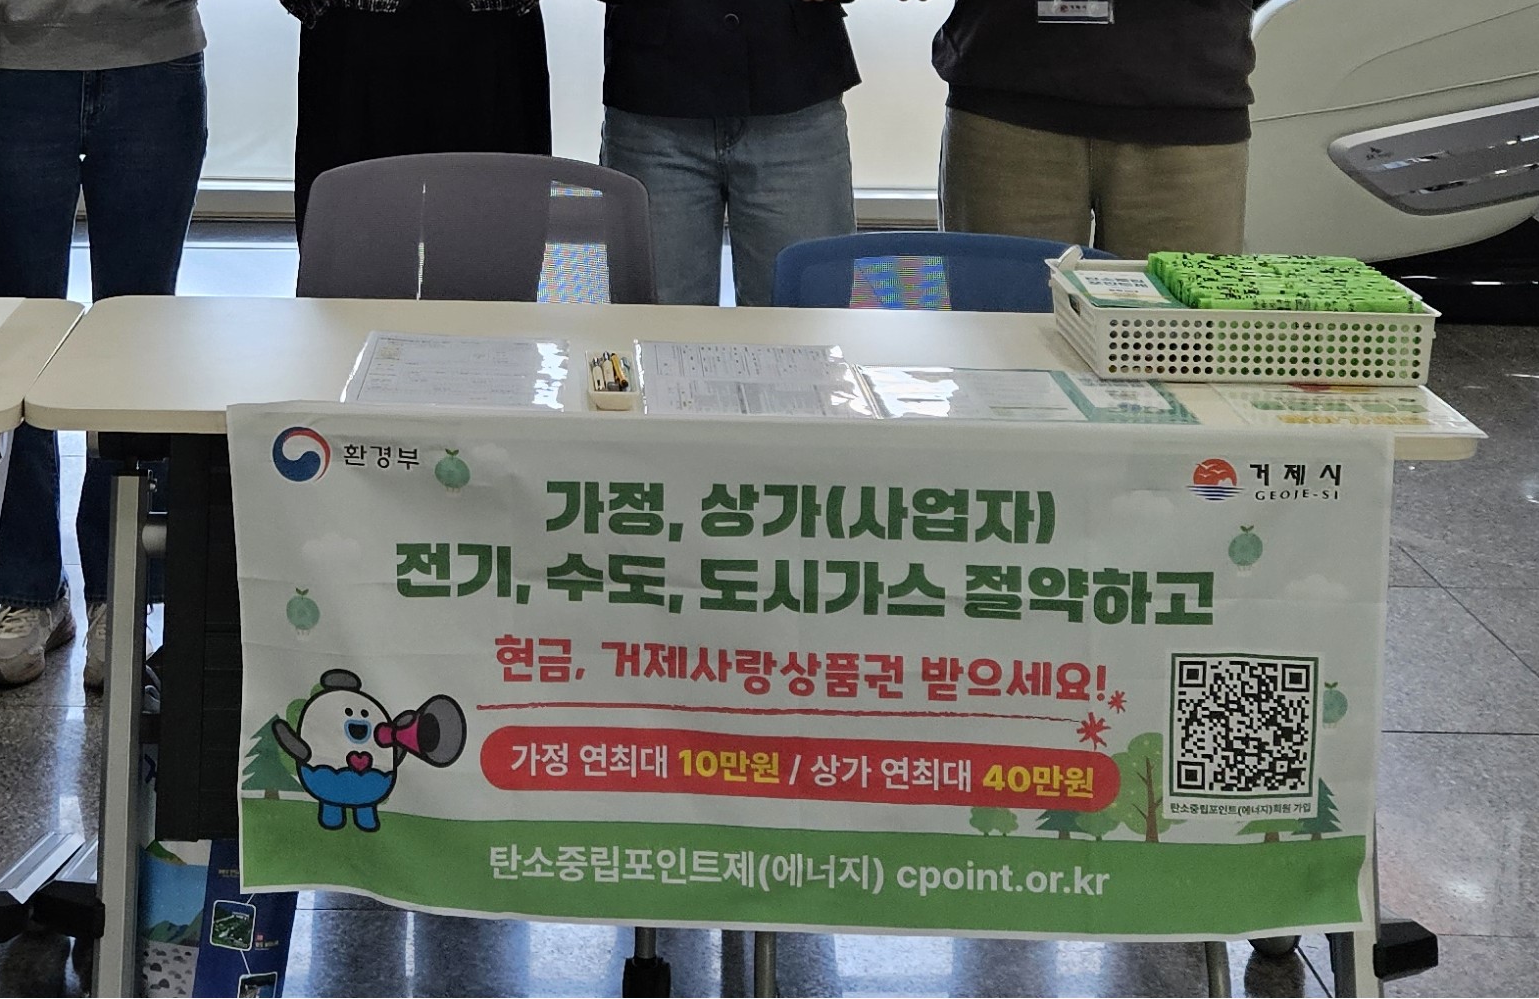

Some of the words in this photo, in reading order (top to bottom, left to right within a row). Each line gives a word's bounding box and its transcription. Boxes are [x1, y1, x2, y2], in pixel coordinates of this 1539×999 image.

[343, 443, 420, 471] 환경부
[1250, 463, 1341, 486] 거제시
[546, 480, 683, 542] 가정,
[701, 482, 1057, 544] 상가(사업자)
[1255, 489, 1338, 501] GEOJE-SI
[395, 543, 531, 604] 전기,
[547, 553, 683, 614] 수도,
[700, 558, 946, 618] 도시가스
[962, 563, 1215, 626] 절약하고
[495, 634, 586, 682] 현금,
[602, 641, 904, 700] 거제사랑상품권
[921, 655, 1108, 702] 받으세요!
[511, 741, 568, 778] 가정
[580, 741, 668, 780] 연최대
[679, 748, 781, 785] 10만원
[810, 755, 872, 788] 상가
[881, 756, 972, 793] 연최대
[982, 763, 1095, 799] 40만원
[489, 845, 884, 892] 탄소중립포인트제(에너지)
[896, 859, 1110, 896] cpoint.or.kr
